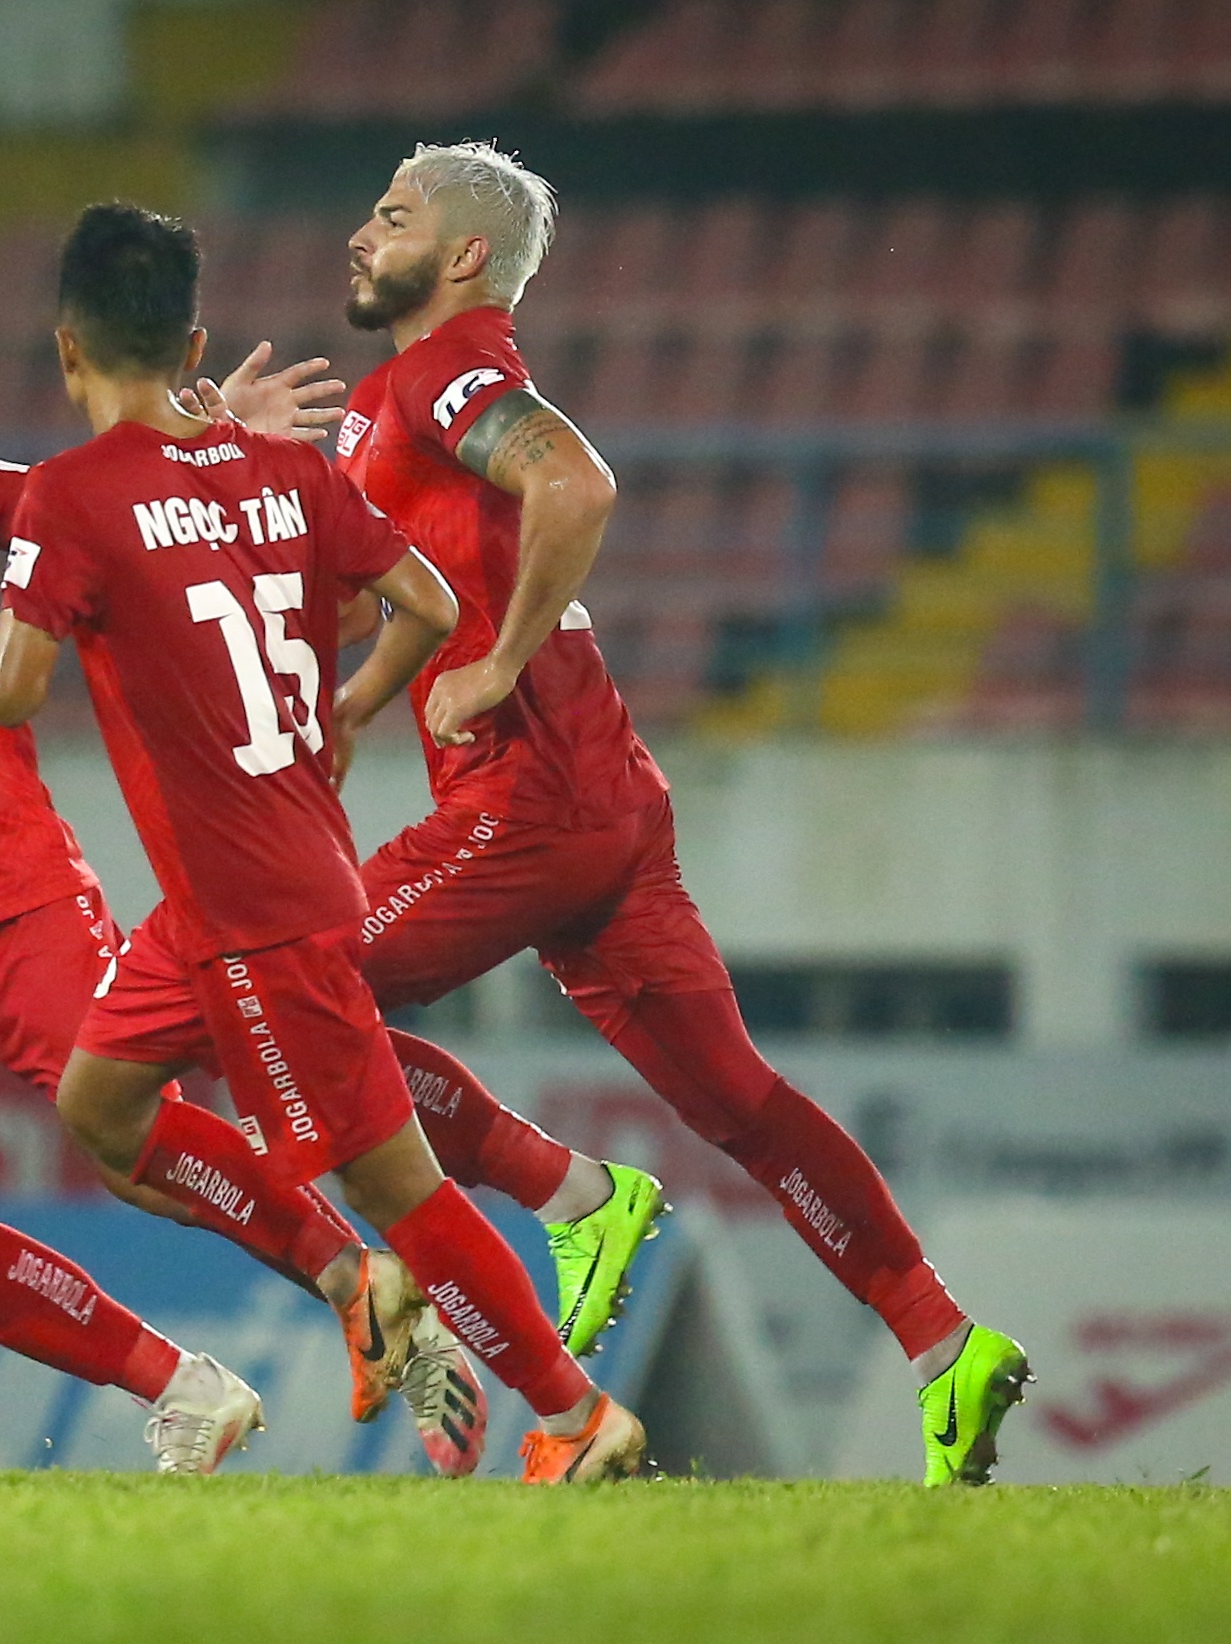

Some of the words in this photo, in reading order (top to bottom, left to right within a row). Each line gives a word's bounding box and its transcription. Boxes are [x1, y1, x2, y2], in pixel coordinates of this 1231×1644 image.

[132, 496, 238, 551] NGỌC
[239, 486, 308, 545] TÂN
[185, 571, 325, 777] 15
[223, 956, 253, 990] JO
[250, 1021, 319, 1143] JOGARBOLA
[166, 1151, 255, 1226] JOGARBOLA
[779, 1167, 852, 1257] JOGARBOLA
[7, 1248, 98, 1325] JOGARBOLA
[427, 1280, 510, 1359] JOGARBOLA
